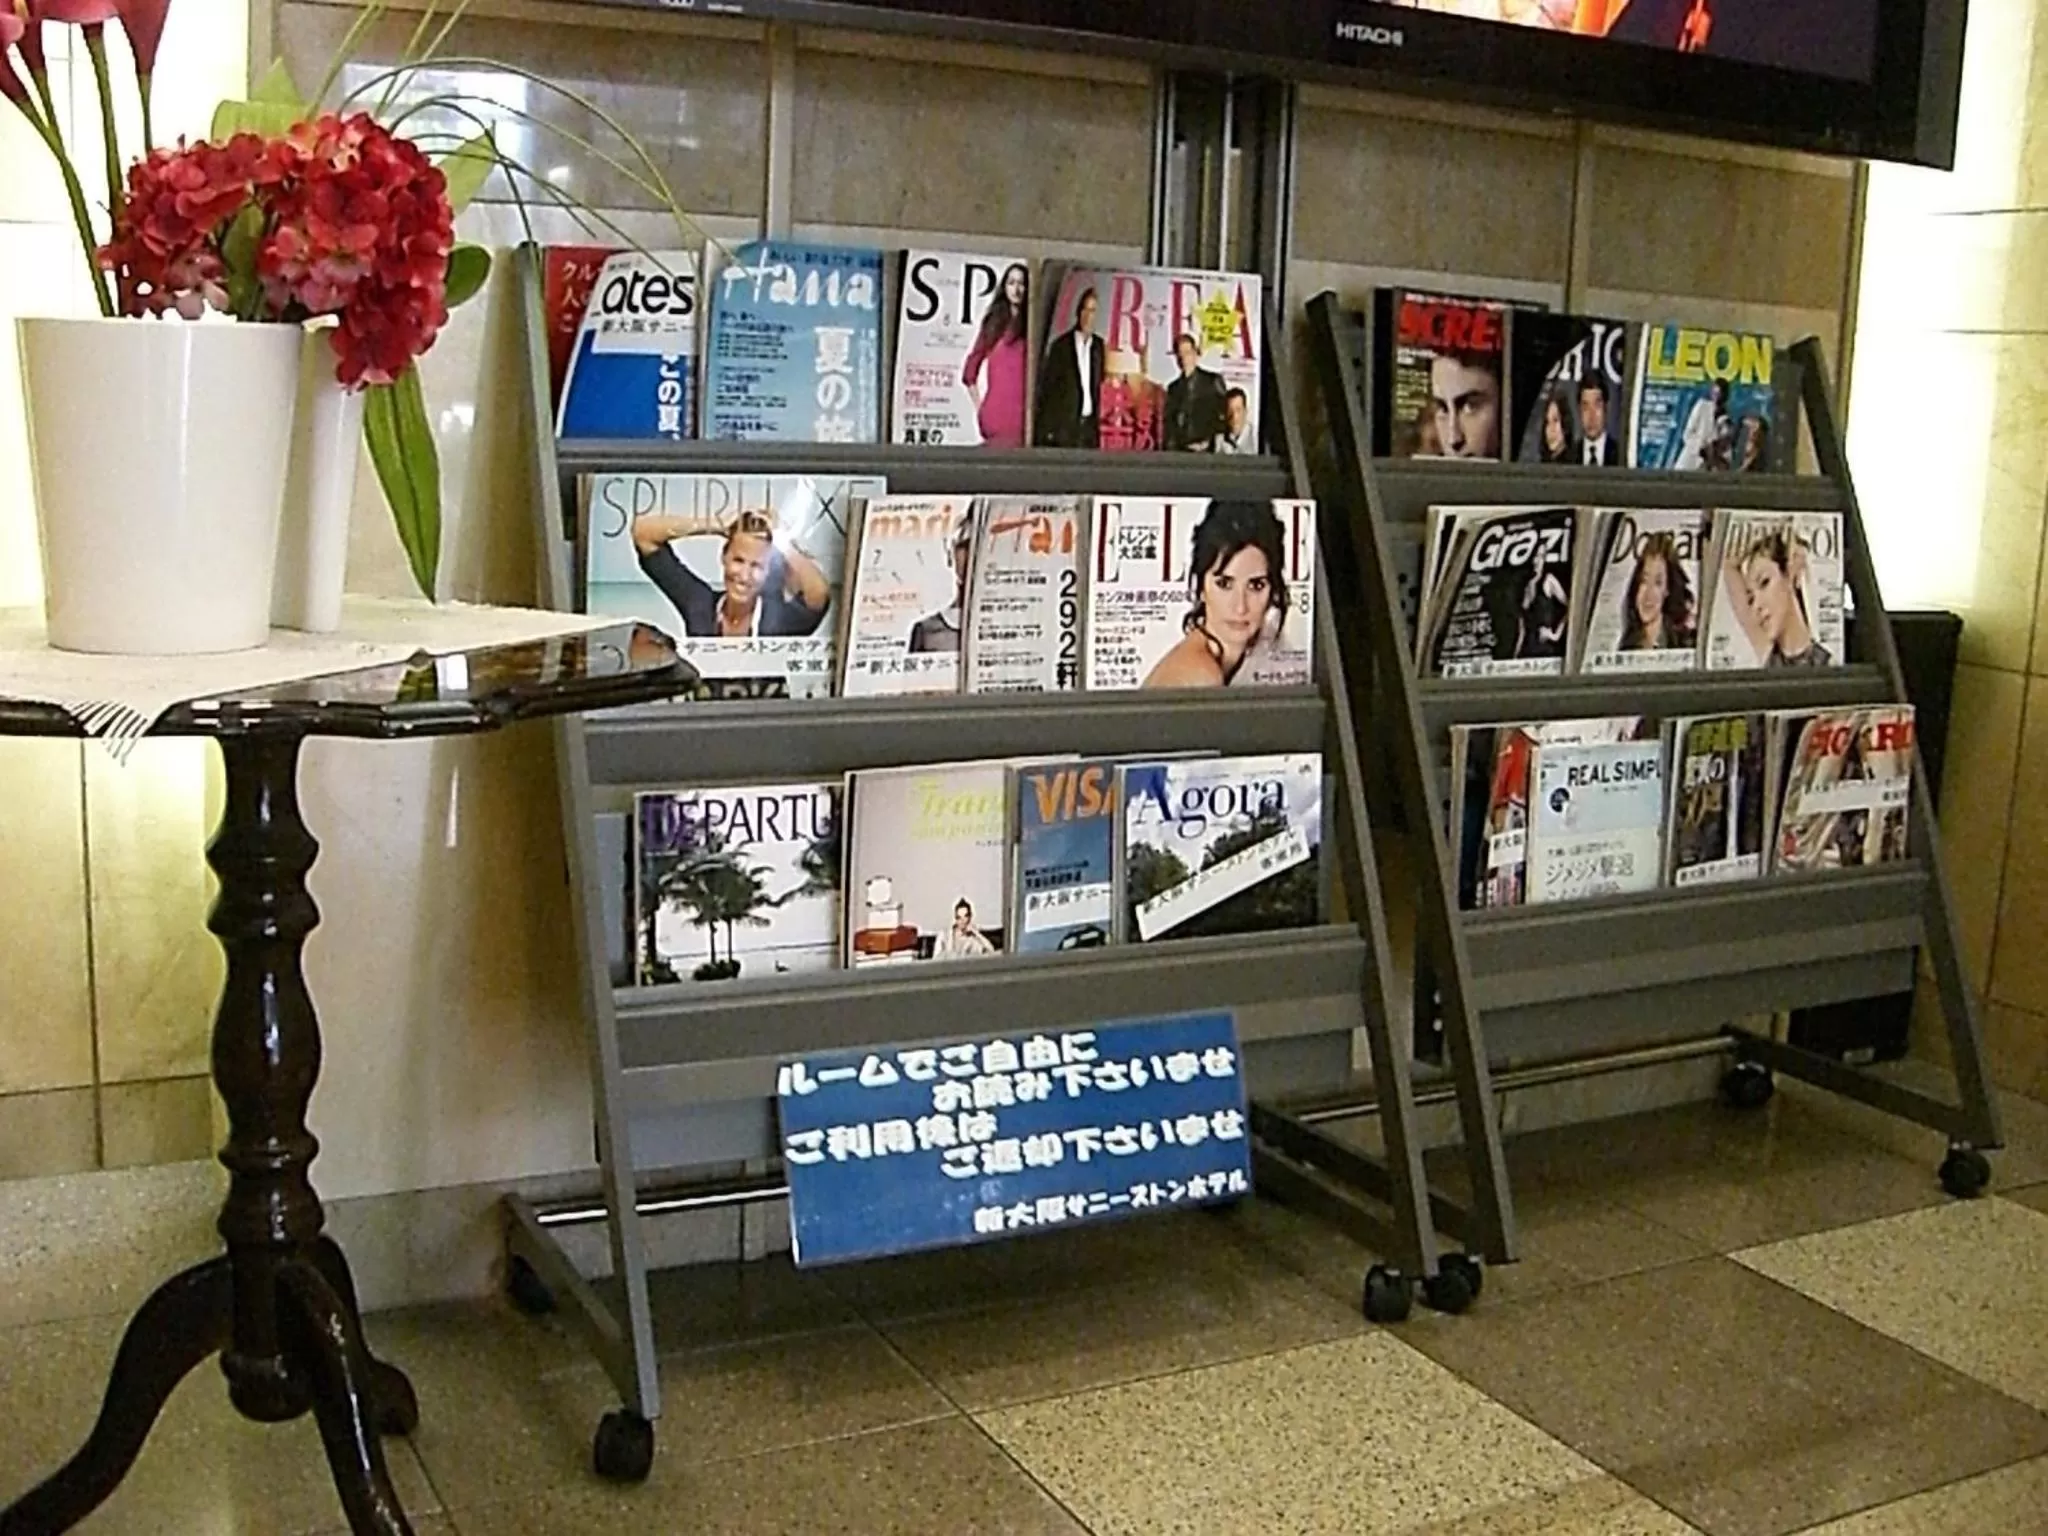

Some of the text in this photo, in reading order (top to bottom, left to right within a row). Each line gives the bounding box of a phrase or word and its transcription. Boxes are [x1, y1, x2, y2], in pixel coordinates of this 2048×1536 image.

[1336, 22, 1403, 47] HITACHI
[1647, 327, 1773, 386] LEON
[1470, 517, 1573, 571] Grazi
[1567, 763, 1611, 787] REAL
[643, 793, 834, 851] DEPARTU
[1128, 775, 1287, 839] Agora
[778, 1031, 1099, 1096] ルームでご自由に
[931, 1047, 1236, 1112] お読み下さいませ
[974, 1169, 1248, 1233] 新大阪サニーストンホテル
